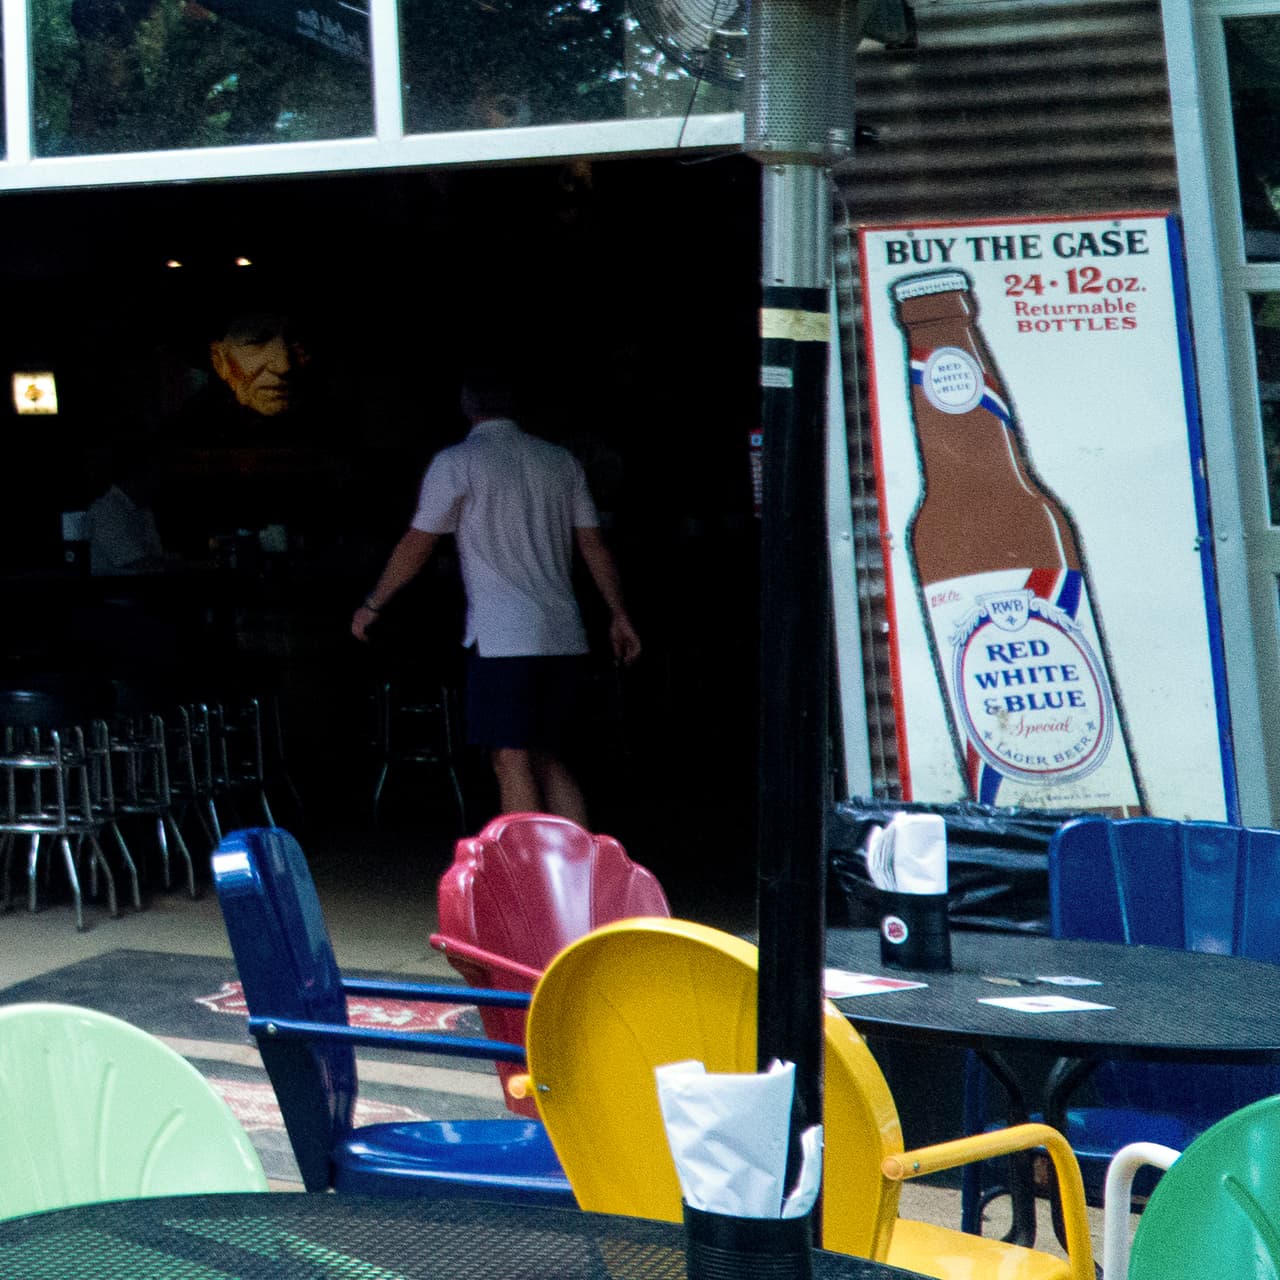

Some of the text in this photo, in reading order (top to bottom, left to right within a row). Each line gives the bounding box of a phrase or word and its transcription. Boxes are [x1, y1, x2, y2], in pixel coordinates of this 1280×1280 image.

[885, 230, 1149, 265] BUY THE CASE
[1004, 274, 1045, 297] 24
[1014, 297, 1137, 317] Returnable
[1017, 317, 1138, 334] BOTTLES
[991, 599, 1024, 614] RWB
[986, 639, 1050, 665] RED
[974, 664, 1079, 690] WHITE
[1011, 715, 1073, 739] Special
[996, 735, 1092, 766] LAGER BEER
